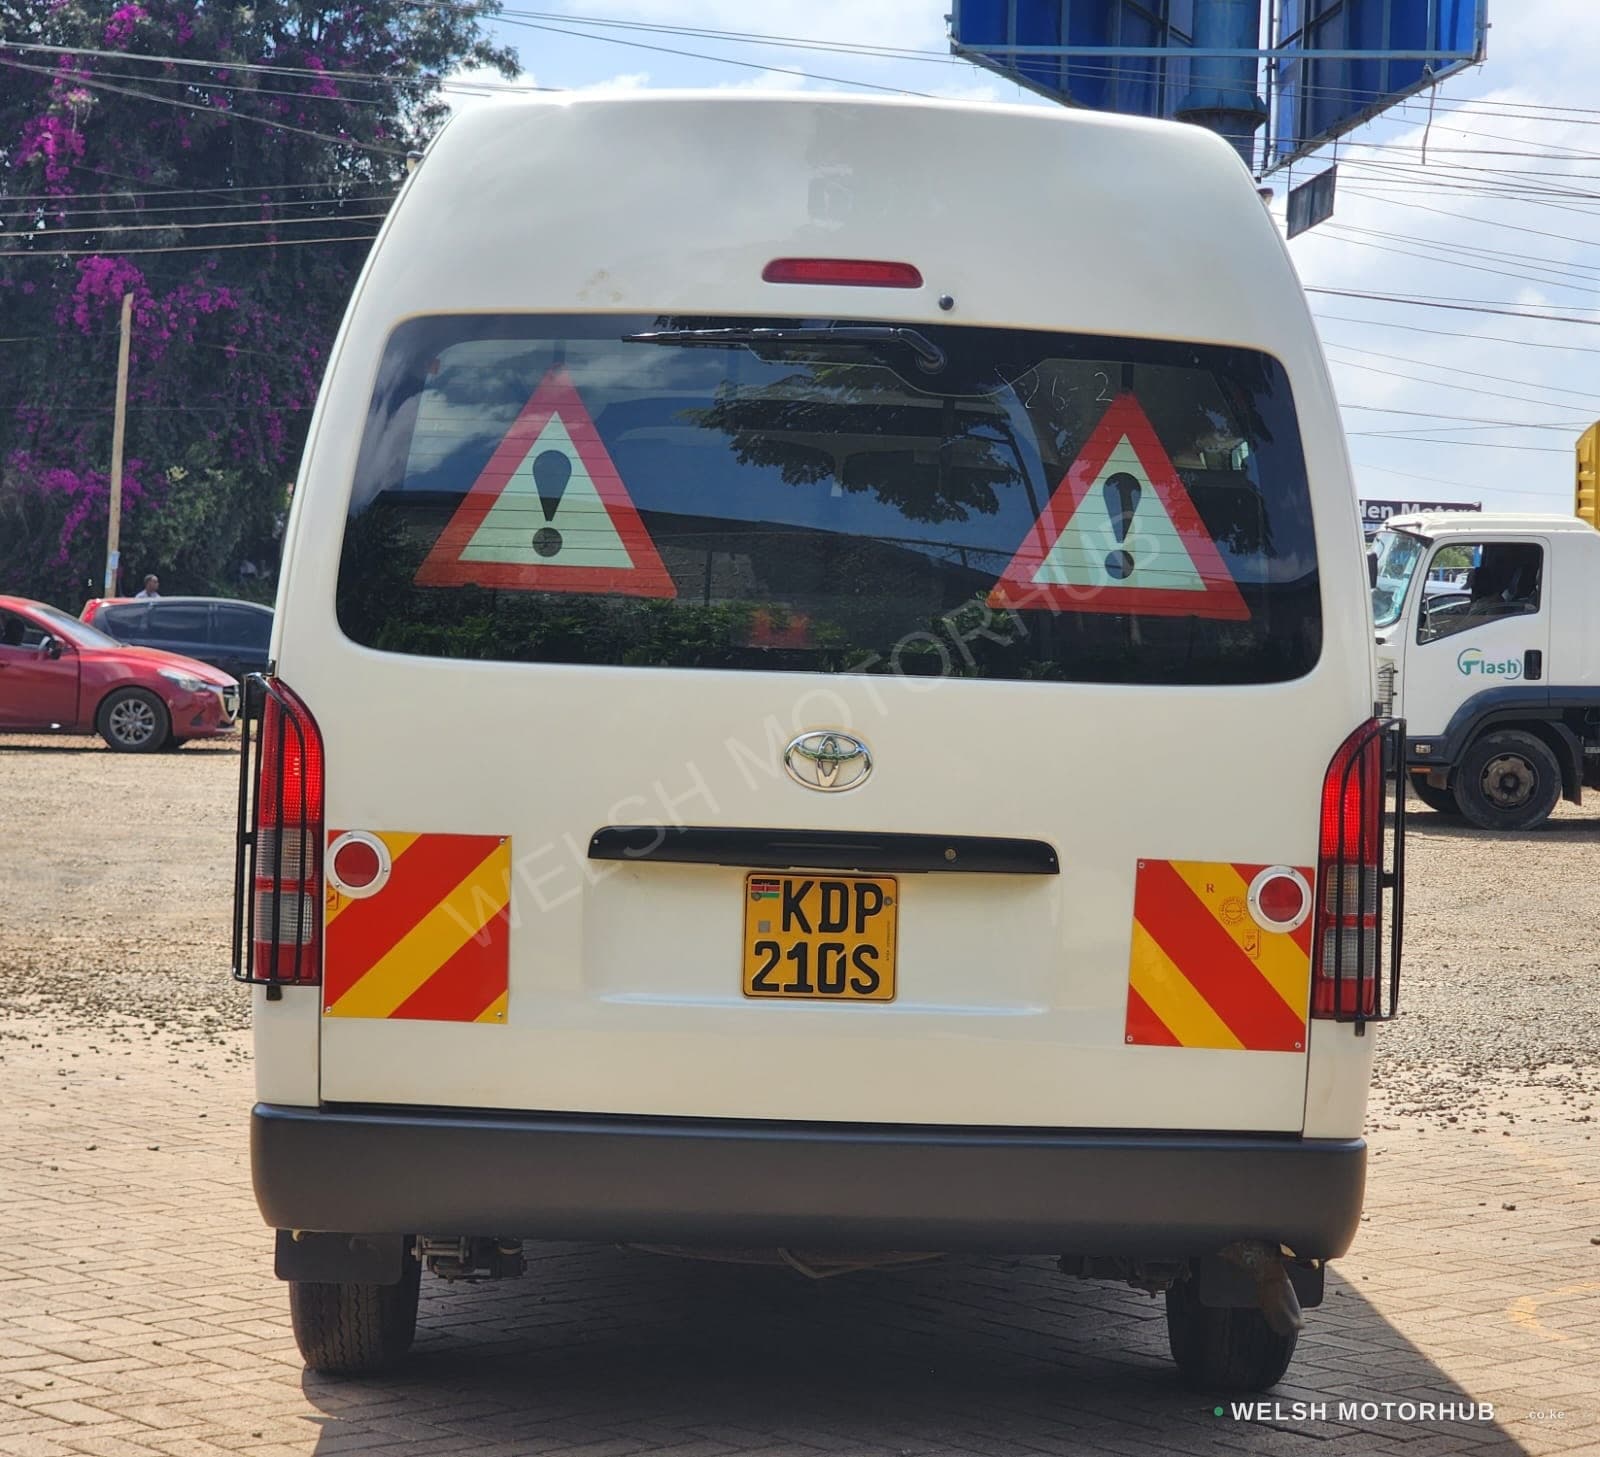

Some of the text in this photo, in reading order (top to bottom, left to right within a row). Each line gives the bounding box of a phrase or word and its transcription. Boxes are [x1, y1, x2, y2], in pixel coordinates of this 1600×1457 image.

[781, 880, 884, 934] KDP
[1206, 883, 1215, 893] R
[752, 941, 880, 994] 210S
